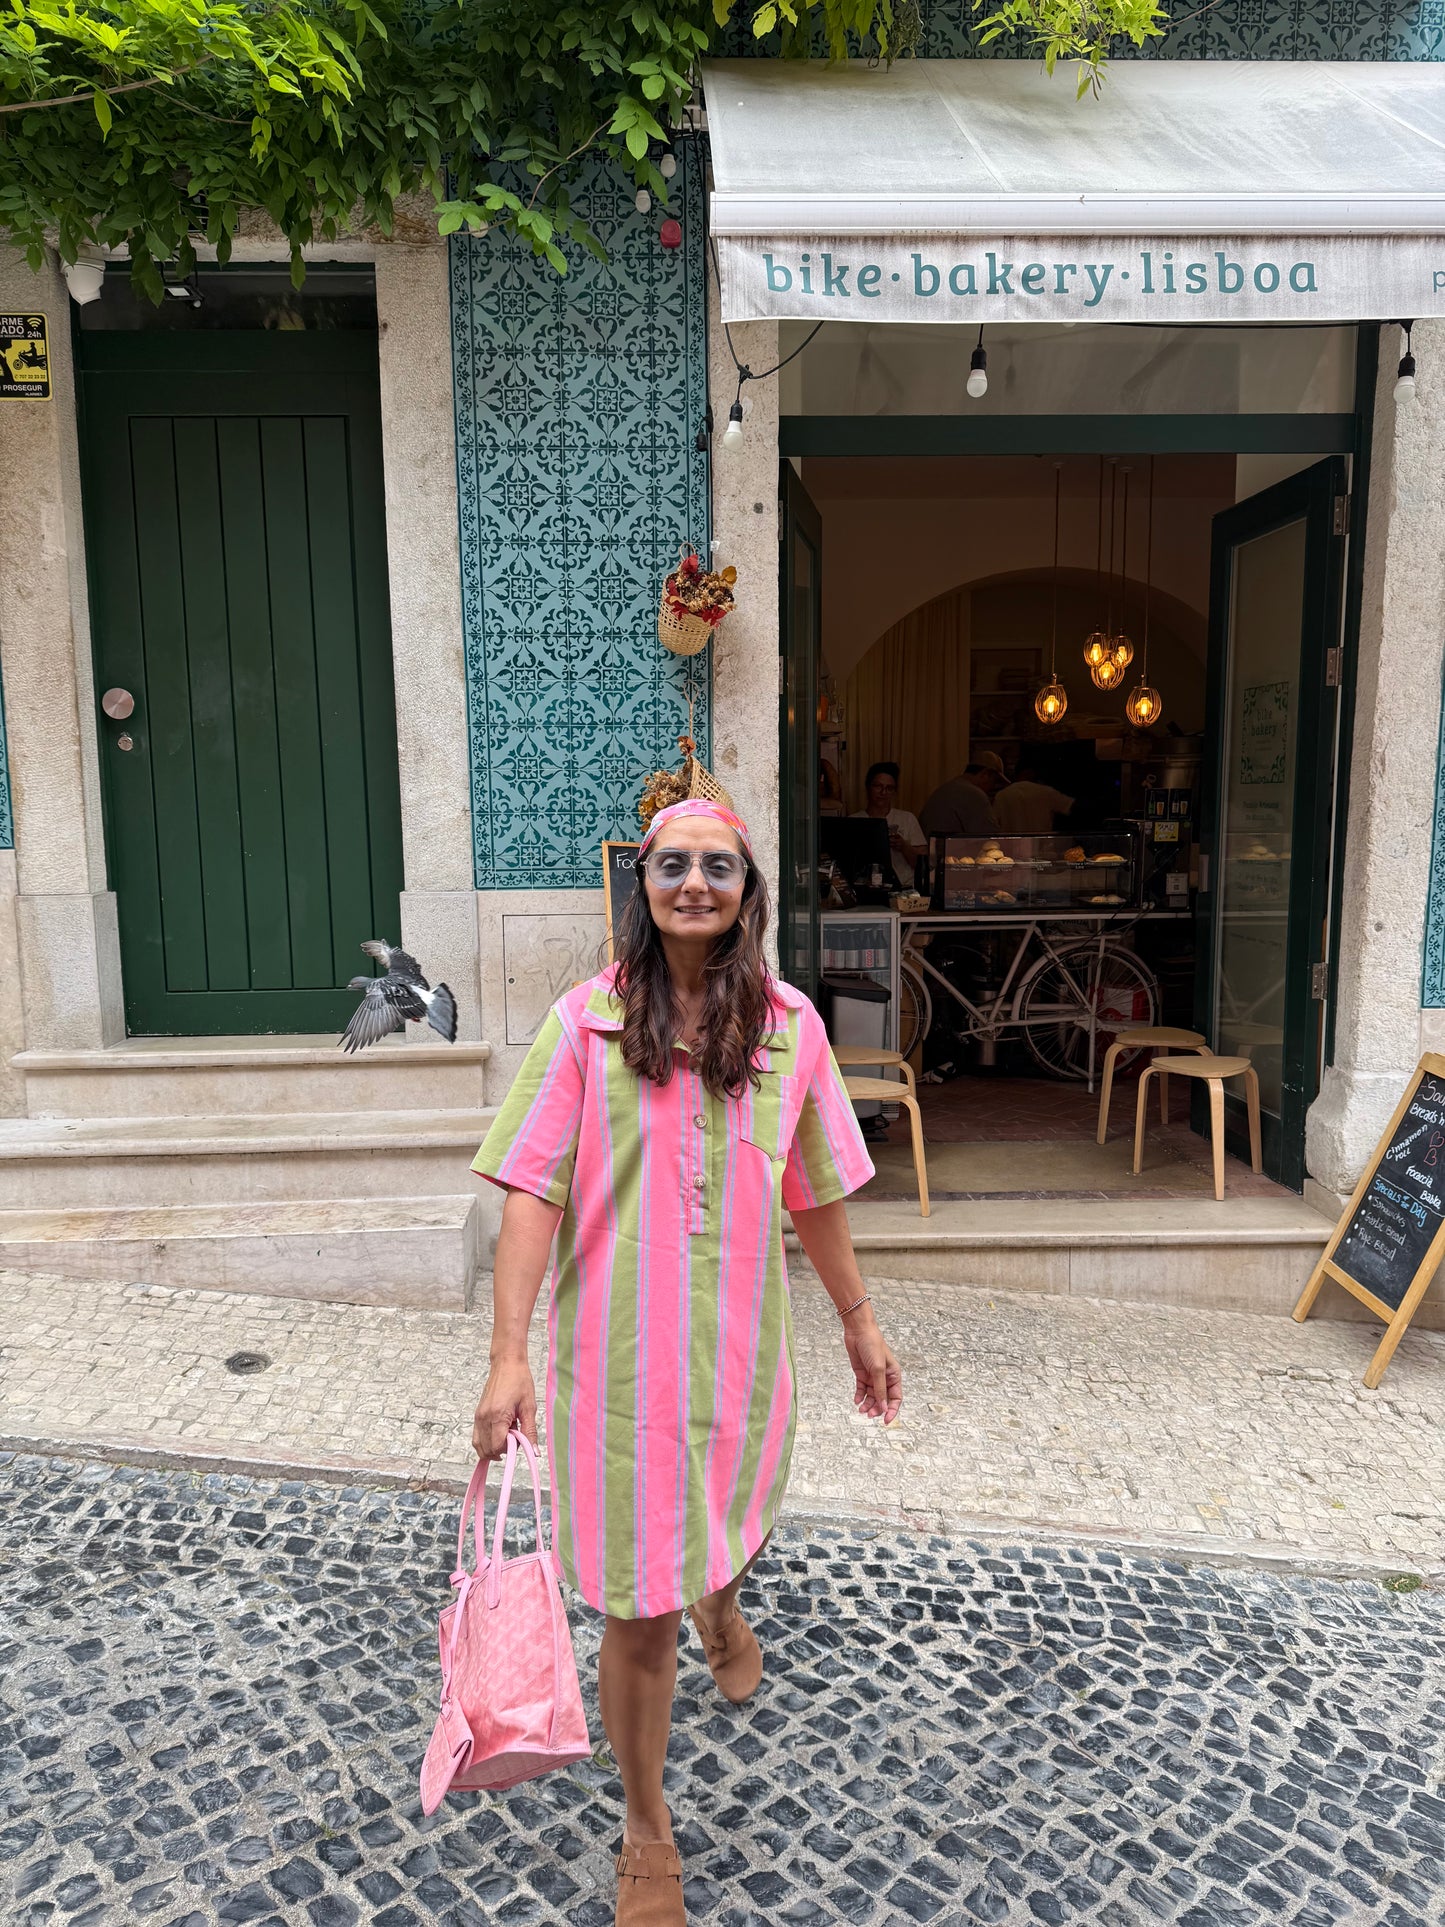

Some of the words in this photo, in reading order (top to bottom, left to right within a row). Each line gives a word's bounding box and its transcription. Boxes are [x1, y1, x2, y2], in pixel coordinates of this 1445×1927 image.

[0, 317, 24, 326] RME
[27, 330, 42, 338] 24h
[2, 384, 43, 392] PROSEGUR
[1409, 1102, 1438, 1124] Breads
[1386, 1124, 1428, 1159] Cinnamon
[1405, 1165, 1434, 1188] Focaccia
[1409, 1201, 1428, 1228] Day
